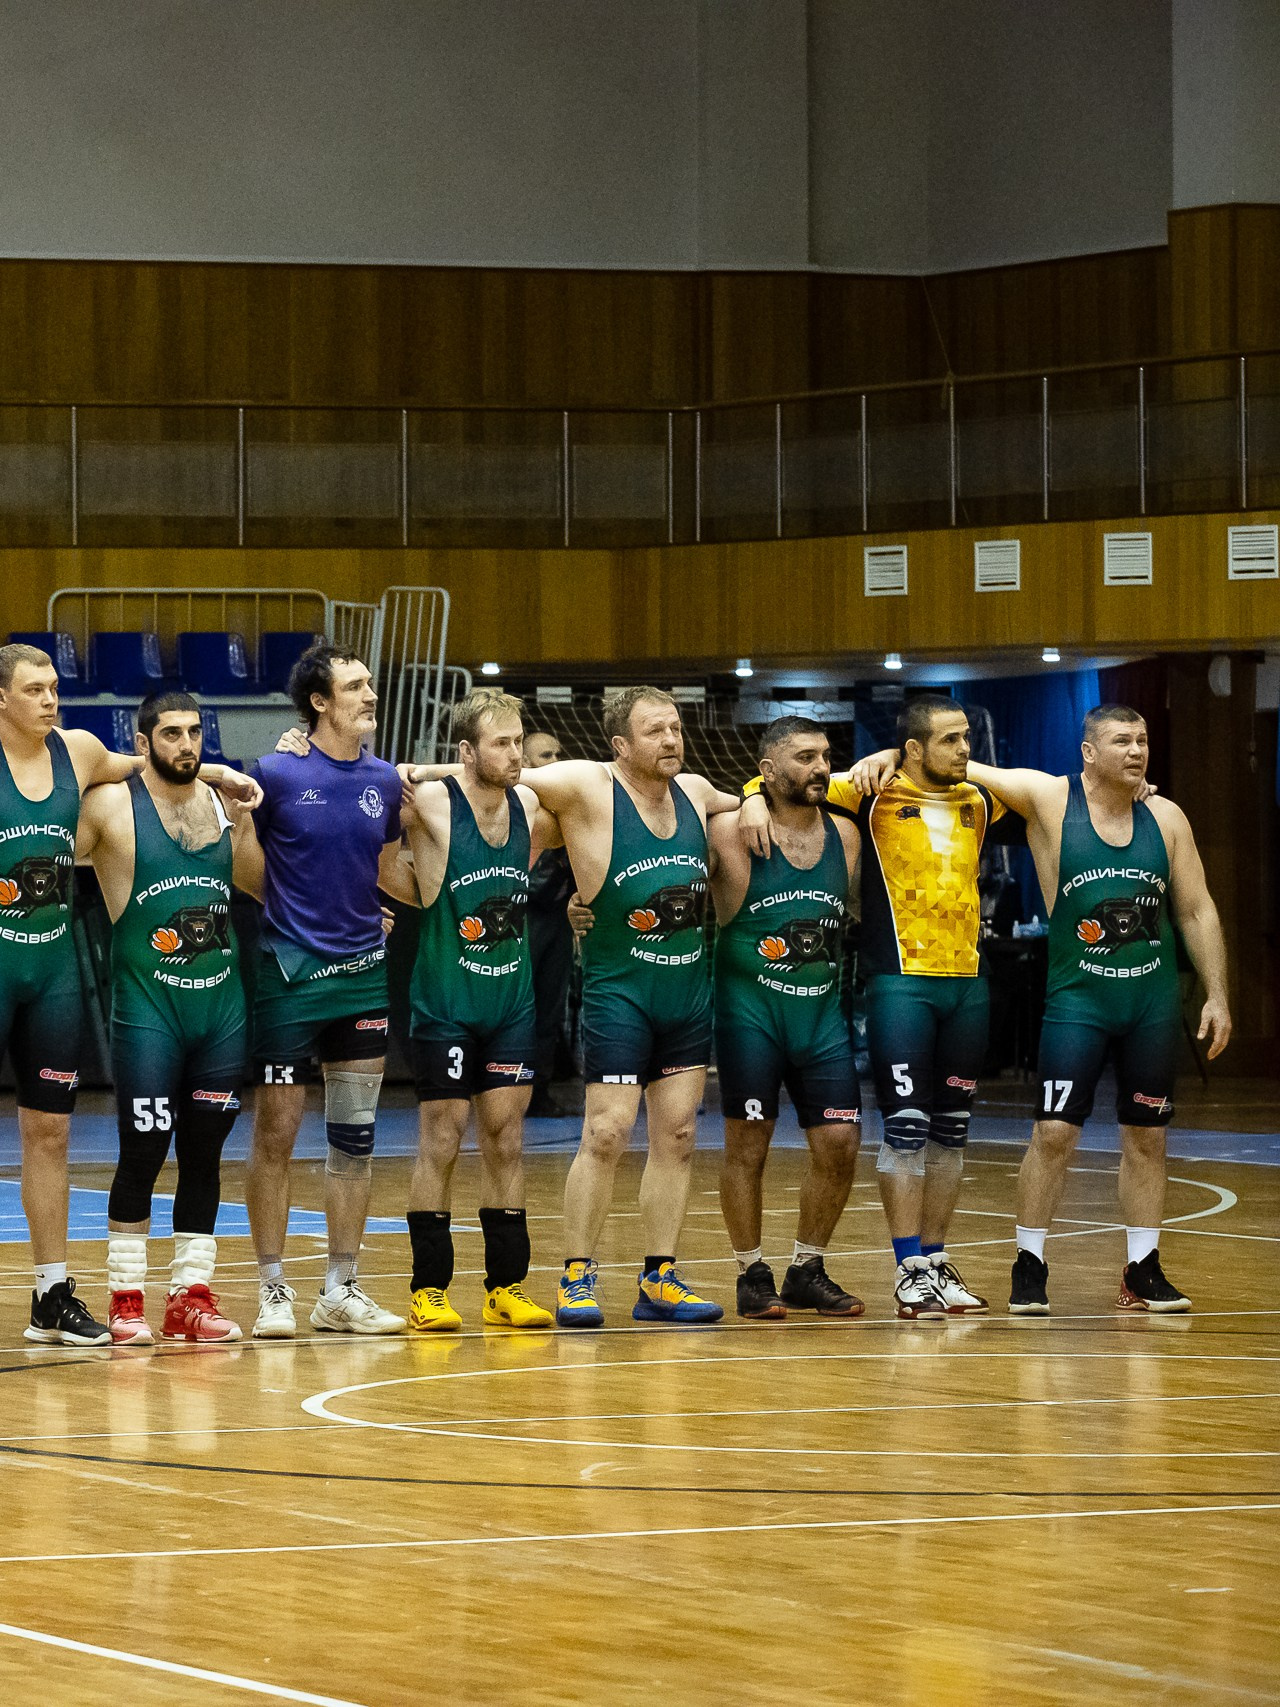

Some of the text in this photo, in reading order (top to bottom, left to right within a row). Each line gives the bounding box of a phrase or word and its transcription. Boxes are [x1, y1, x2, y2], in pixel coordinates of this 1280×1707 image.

[449, 866, 530, 893] РОЩИНСКИ
[1062, 867, 1167, 897] РОЩИНСКИЕ
[153, 966, 231, 989] МЕДВЕДИ
[1078, 957, 1161, 978] МЕДВЕДИ
[447, 1046, 464, 1080] 3
[891, 1063, 914, 1097] 5
[1043, 1080, 1073, 1112] 17
[133, 1097, 172, 1132] 55
